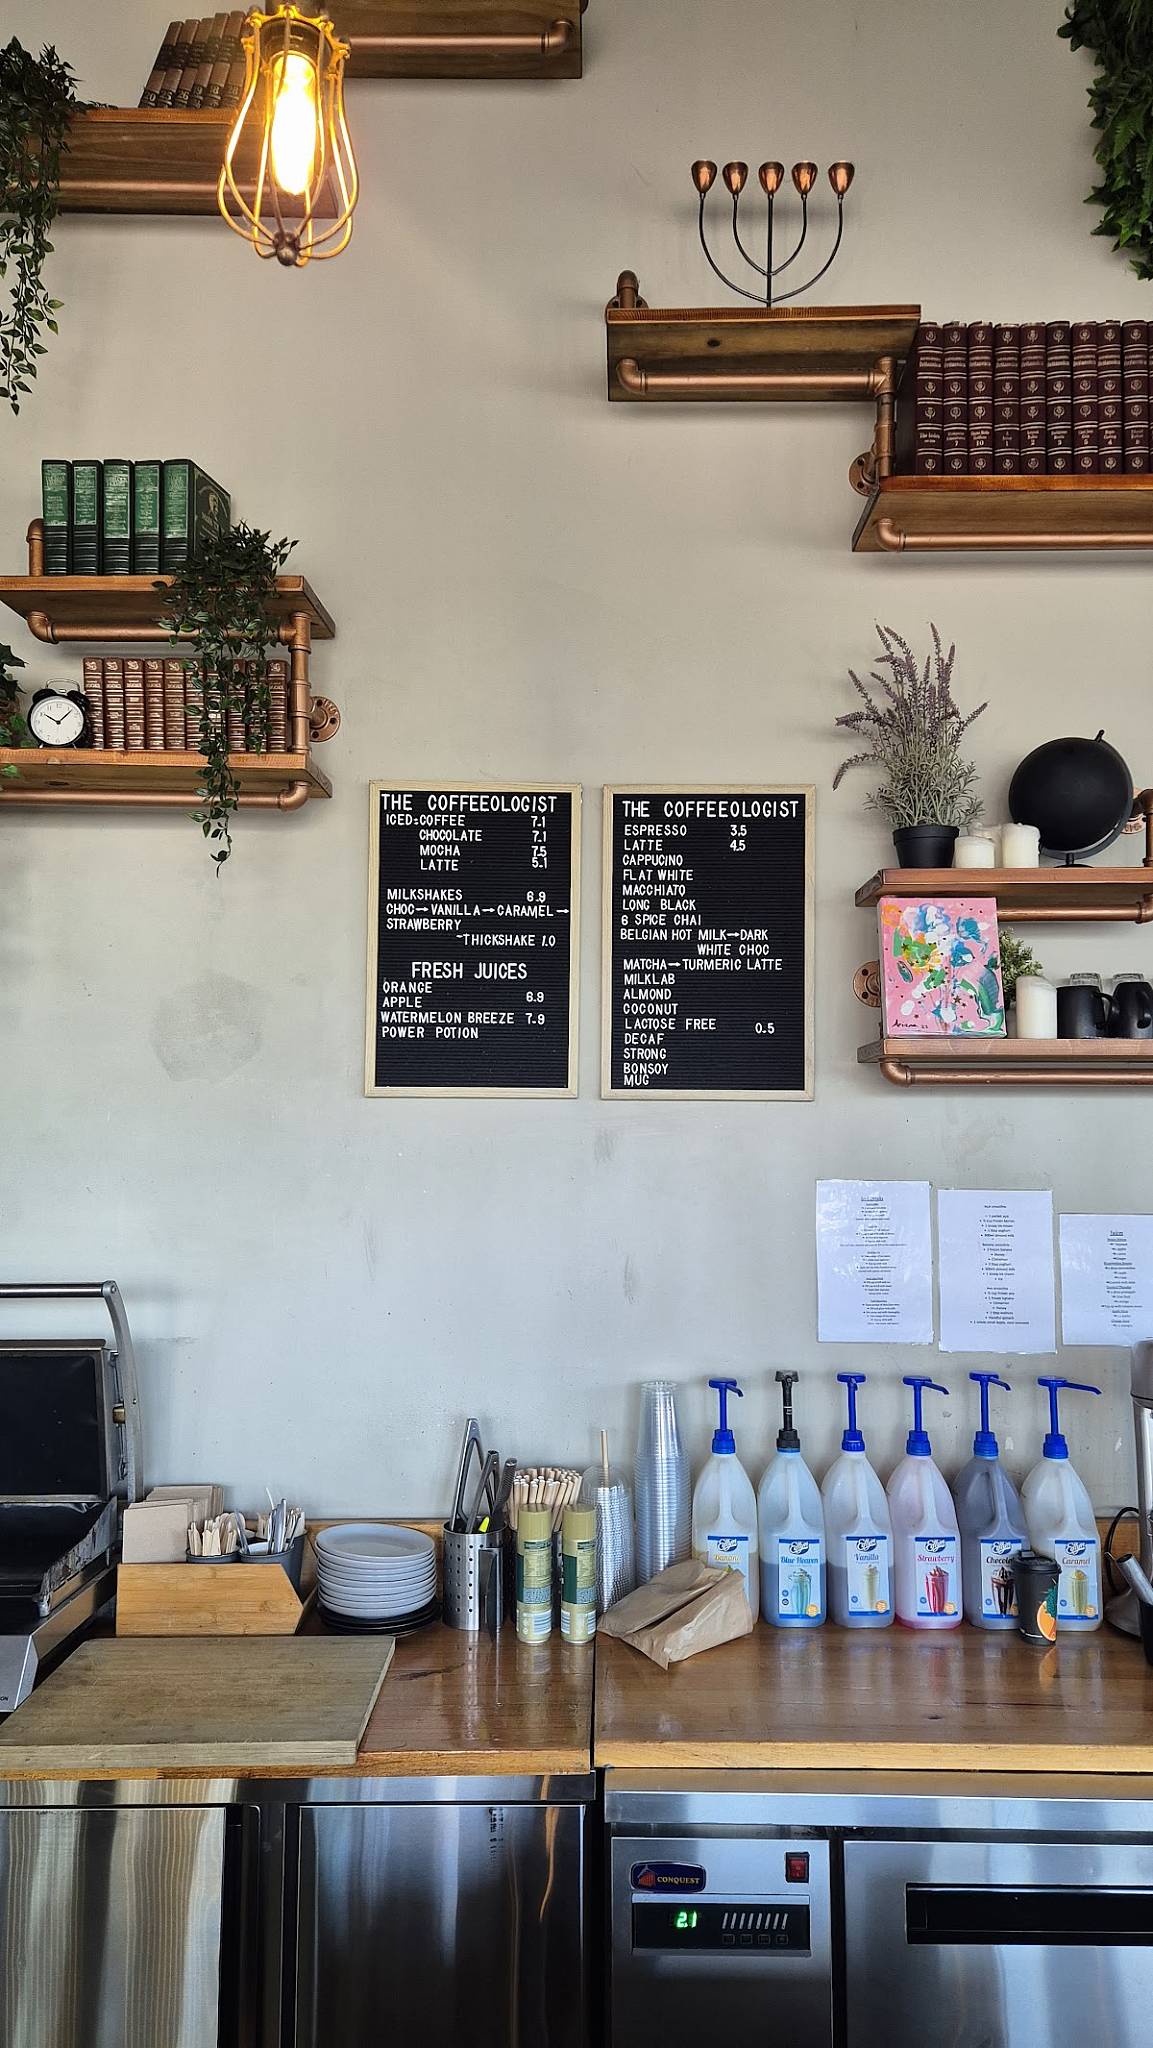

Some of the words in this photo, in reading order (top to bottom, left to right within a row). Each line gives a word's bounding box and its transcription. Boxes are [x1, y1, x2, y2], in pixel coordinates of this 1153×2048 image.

[381, 794, 412, 811] THE
[428, 795, 557, 813] COFFEEOLOGIST
[622, 801, 650, 817] THE
[664, 801, 798, 817] COFFEEOLOGIST
[531, 816, 545, 827] 7.1
[419, 829, 482, 842] CHOCOLATE
[532, 830, 546, 842] 7.1
[625, 825, 686, 836] ESPRESSO
[731, 825, 747, 836] 3.5
[420, 845, 460, 856] MOCHA
[625, 839, 662, 851] LATTE
[730, 840, 745, 851] 4.5
[421, 859, 458, 871] LATTE
[623, 854, 683, 866] CAPPUCINO
[624, 869, 653, 881] FLAT
[658, 869, 693, 880] WHITE
[388, 889, 462, 900] MILKSHAKES
[527, 891, 546, 903] 6.9
[623, 884, 685, 896] MACCHIATO
[386, 903, 414, 915] CHOC
[431, 904, 480, 916] VANILLA
[497, 904, 553, 918] CARAMEL
[623, 899, 649, 911] LONG
[661, 899, 696, 911] BLACK
[387, 918, 461, 931] STRAWBERRY
[635, 914, 666, 925] SPICE
[674, 914, 701, 925] CHAI
[621, 928, 667, 940] BELGIAN
[672, 929, 692, 940] HOT
[698, 929, 726, 940] MILK
[739, 929, 768, 940] DARK
[697, 944, 731, 955] WHITE
[739, 944, 769, 956] CHOC
[624, 958, 667, 970] MATCHA
[682, 959, 741, 970] TURMERIC
[747, 958, 782, 970] LATTE
[412, 962, 463, 978] FRESH
[474, 962, 527, 979] JUICES
[624, 973, 675, 985] MILKLAB
[383, 981, 432, 993] ORANGE
[383, 996, 422, 1008] APPLE
[526, 991, 544, 1002] 6.9
[624, 988, 671, 1000] ALMOND
[623, 1003, 678, 1015] COCONUT
[381, 1011, 461, 1023] WATERMELON
[468, 1012, 514, 1024] BREEZE
[526, 1013, 545, 1025] 7.9
[382, 1026, 424, 1038] POWER
[436, 1027, 478, 1038] POTION
[625, 1018, 676, 1030] LACTOSE
[686, 1018, 716, 1030] FREE
[755, 1023, 774, 1034] 0.5
[625, 1033, 664, 1045] DECAF
[624, 1048, 666, 1060] STRONG
[624, 1063, 668, 1076] BONSOY
[624, 1074, 649, 1087] MUG
[781, 1556, 794, 1564] Blue
[797, 1556, 818, 1564] Heaven
[917, 1554, 955, 1563] Strawberry
[657, 1876, 700, 1884] CONQUEST
